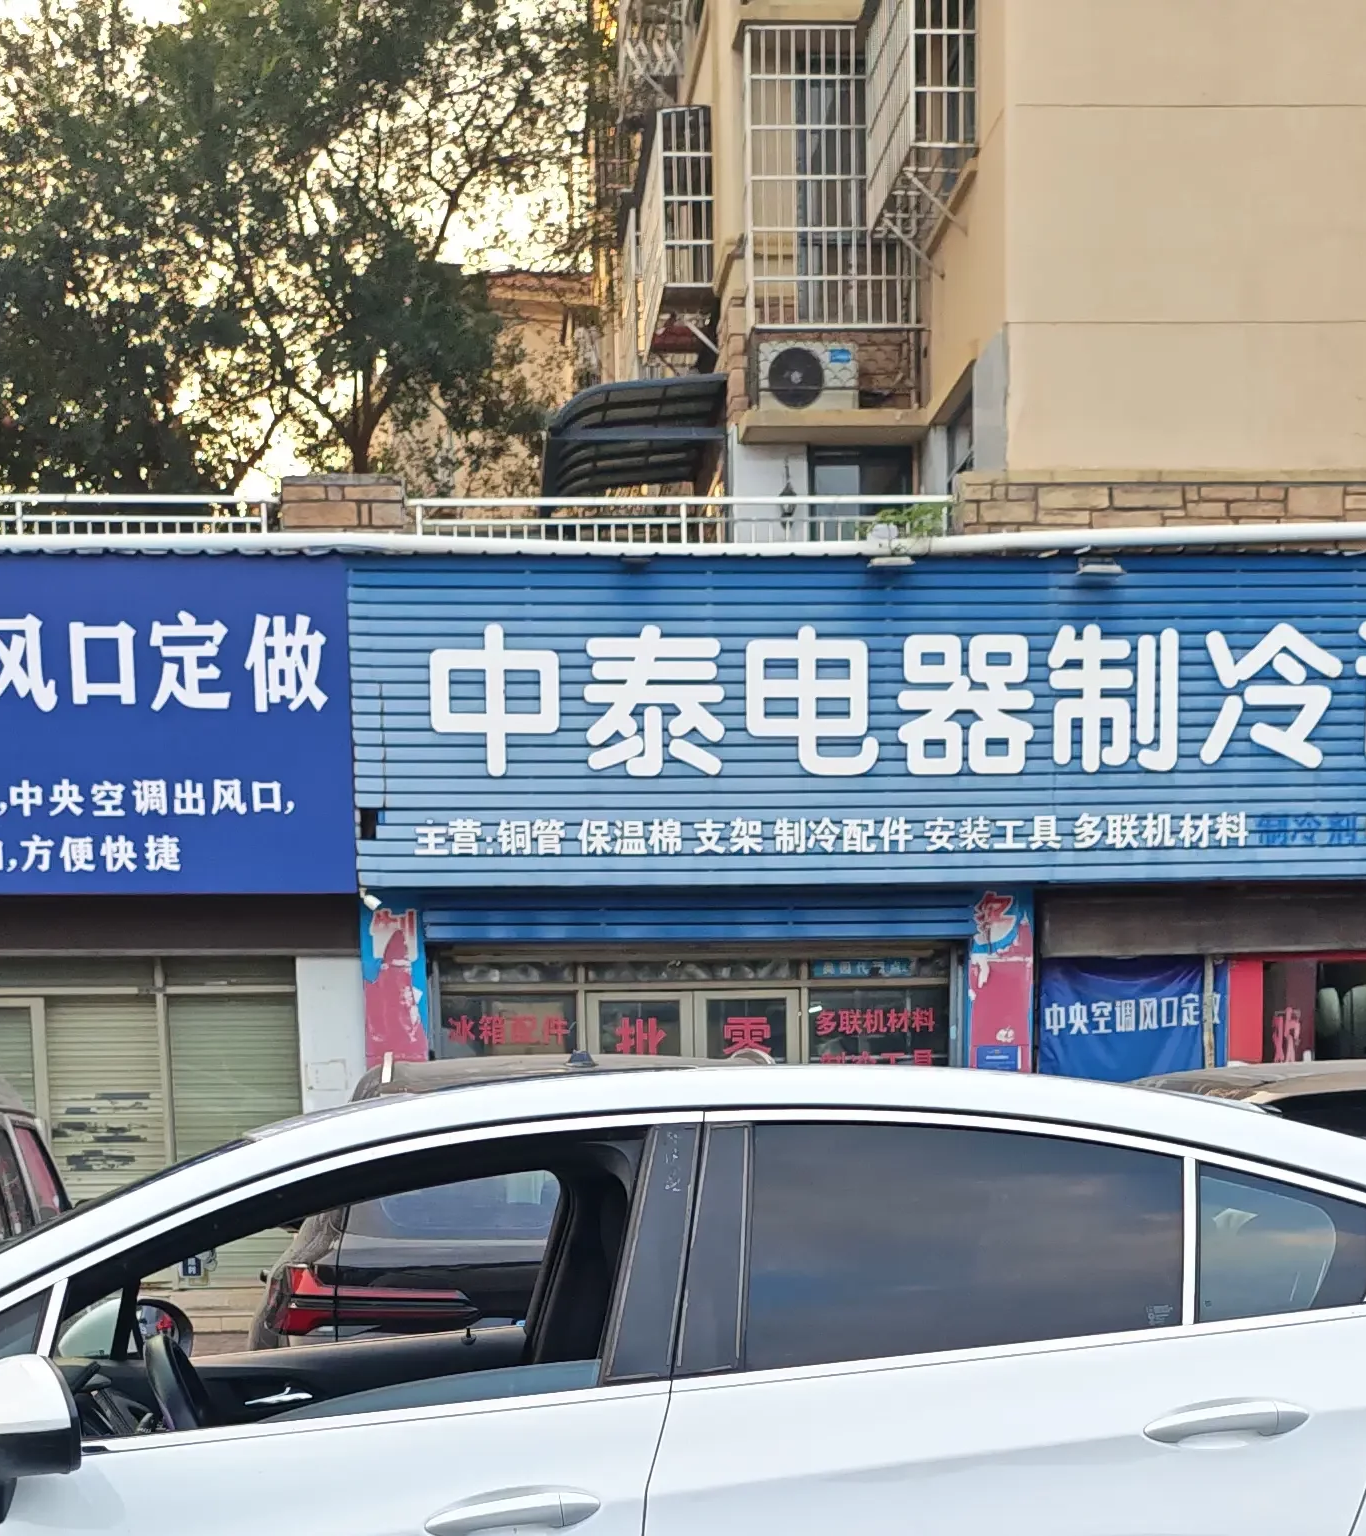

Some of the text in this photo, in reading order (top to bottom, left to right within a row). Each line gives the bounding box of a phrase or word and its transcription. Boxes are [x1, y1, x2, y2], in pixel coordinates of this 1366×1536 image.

[577, 818, 684, 857] 保温棉
[693, 817, 765, 856] 支架
[773, 816, 915, 855] 制冷配件
[923, 814, 1063, 853] 安装工具
[1073, 811, 1250, 850] 多联机材料
[448, 1014, 570, 1046] 冰箱配件
[816, 1007, 935, 1036] 多联机材料
